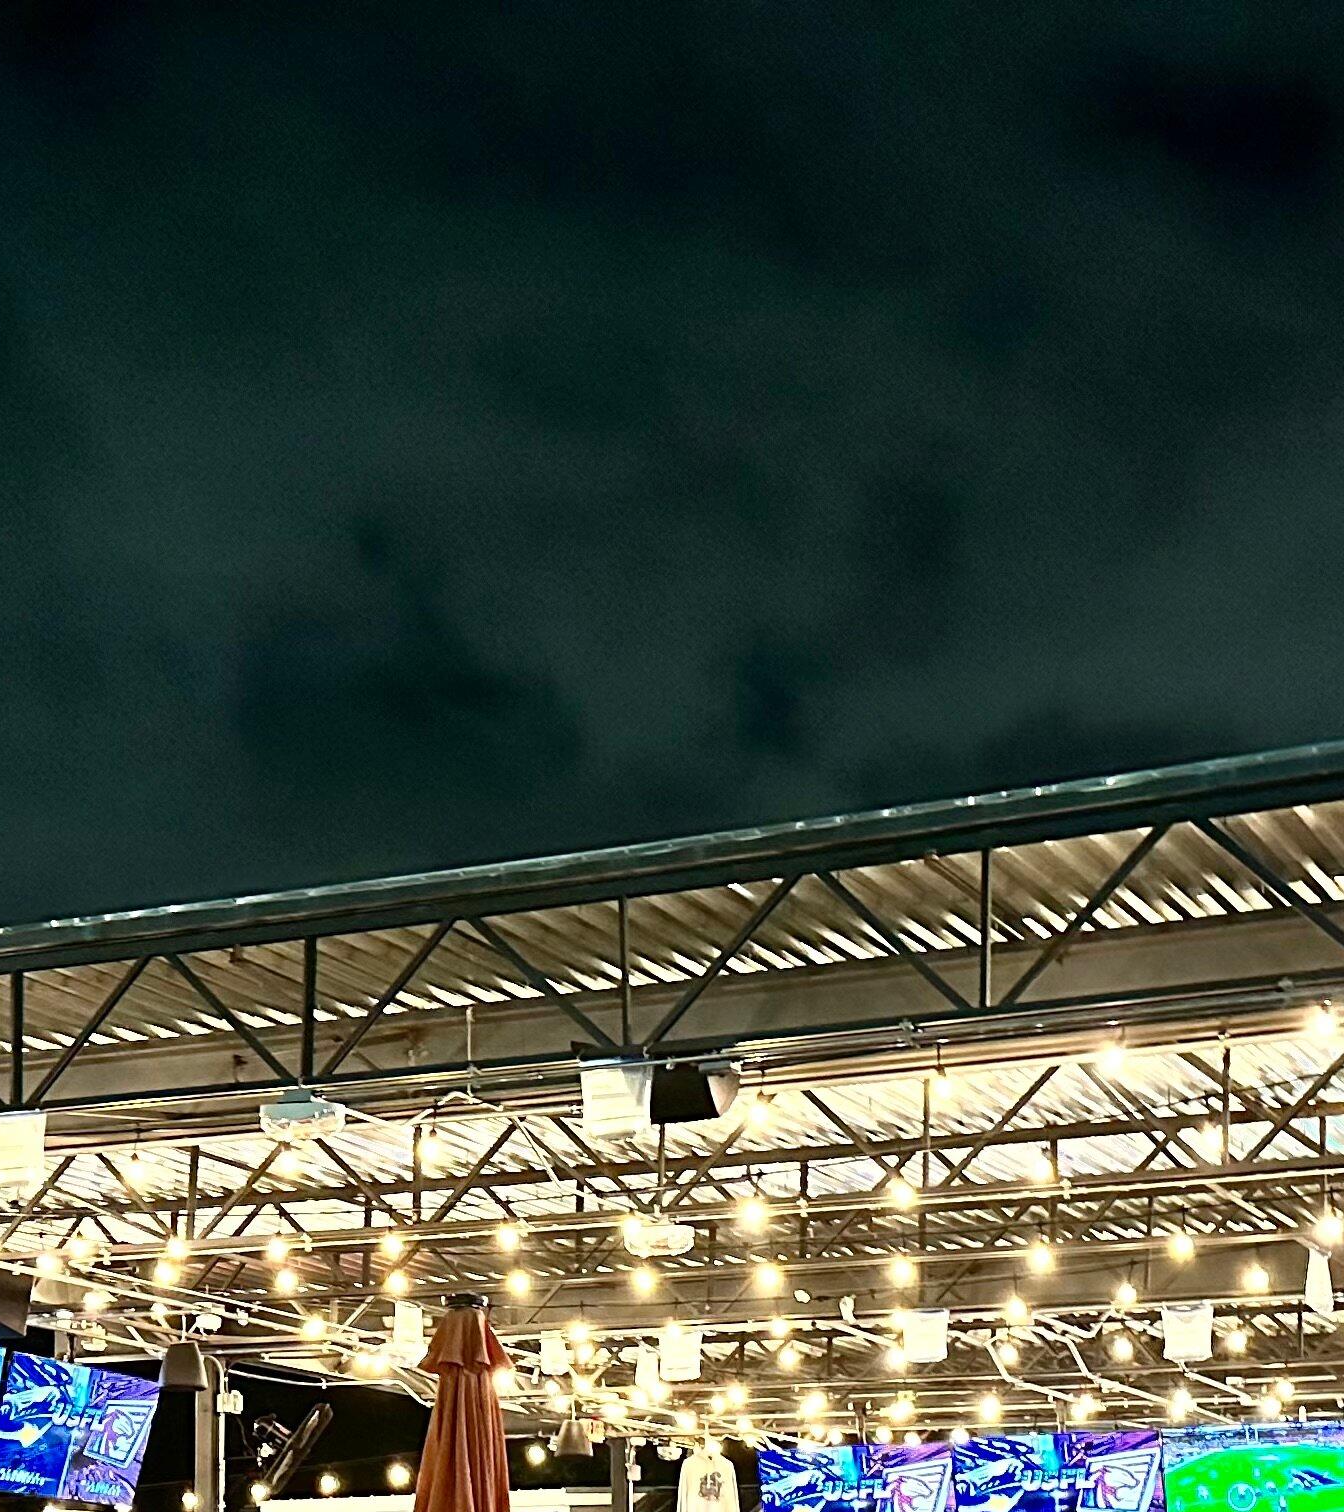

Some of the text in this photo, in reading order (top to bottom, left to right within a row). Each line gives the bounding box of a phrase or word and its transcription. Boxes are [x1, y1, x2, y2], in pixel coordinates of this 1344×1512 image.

[52, 1402, 104, 1432] USFL
[822, 1479, 893, 1501] USFL
[1020, 1467, 1096, 1491] USFL
